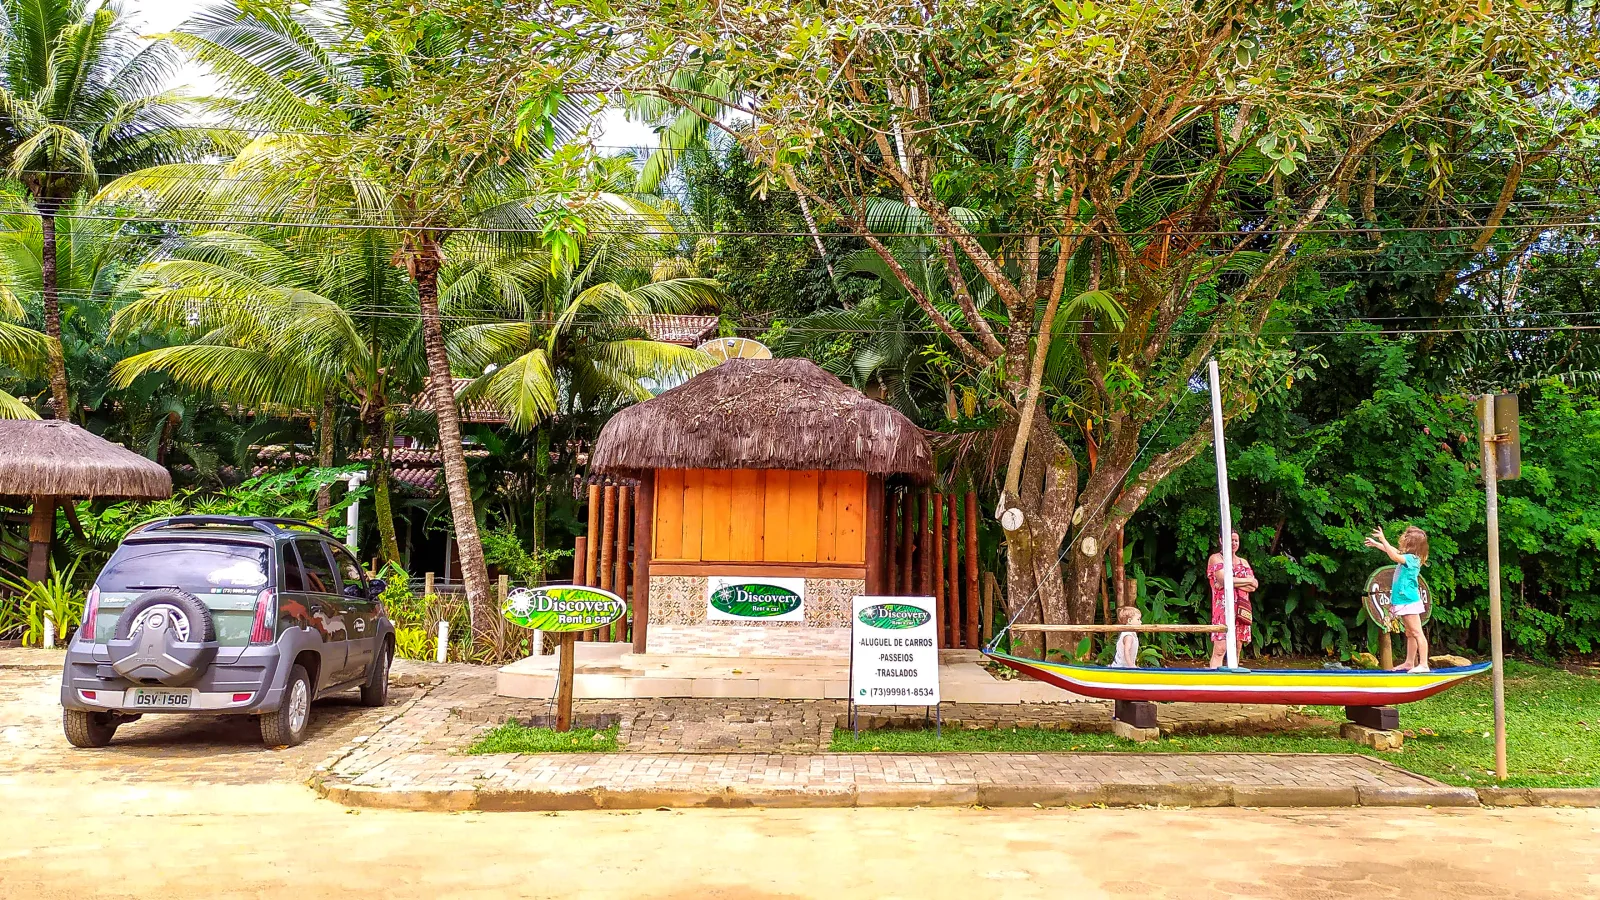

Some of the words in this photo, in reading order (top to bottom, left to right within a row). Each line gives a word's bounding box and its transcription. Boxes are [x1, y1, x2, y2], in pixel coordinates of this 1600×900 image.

[736, 589, 798, 607] Discovery
[536, 595, 620, 617] Discovery
[558, 614, 583, 624] Rent
[585, 616, 592, 624] a
[594, 616, 611, 624] car
[878, 608, 928, 622] Discovery
[893, 638, 903, 647] DE
[904, 638, 933, 647] CARROS
[870, 687, 934, 697] (73)99981-8534
